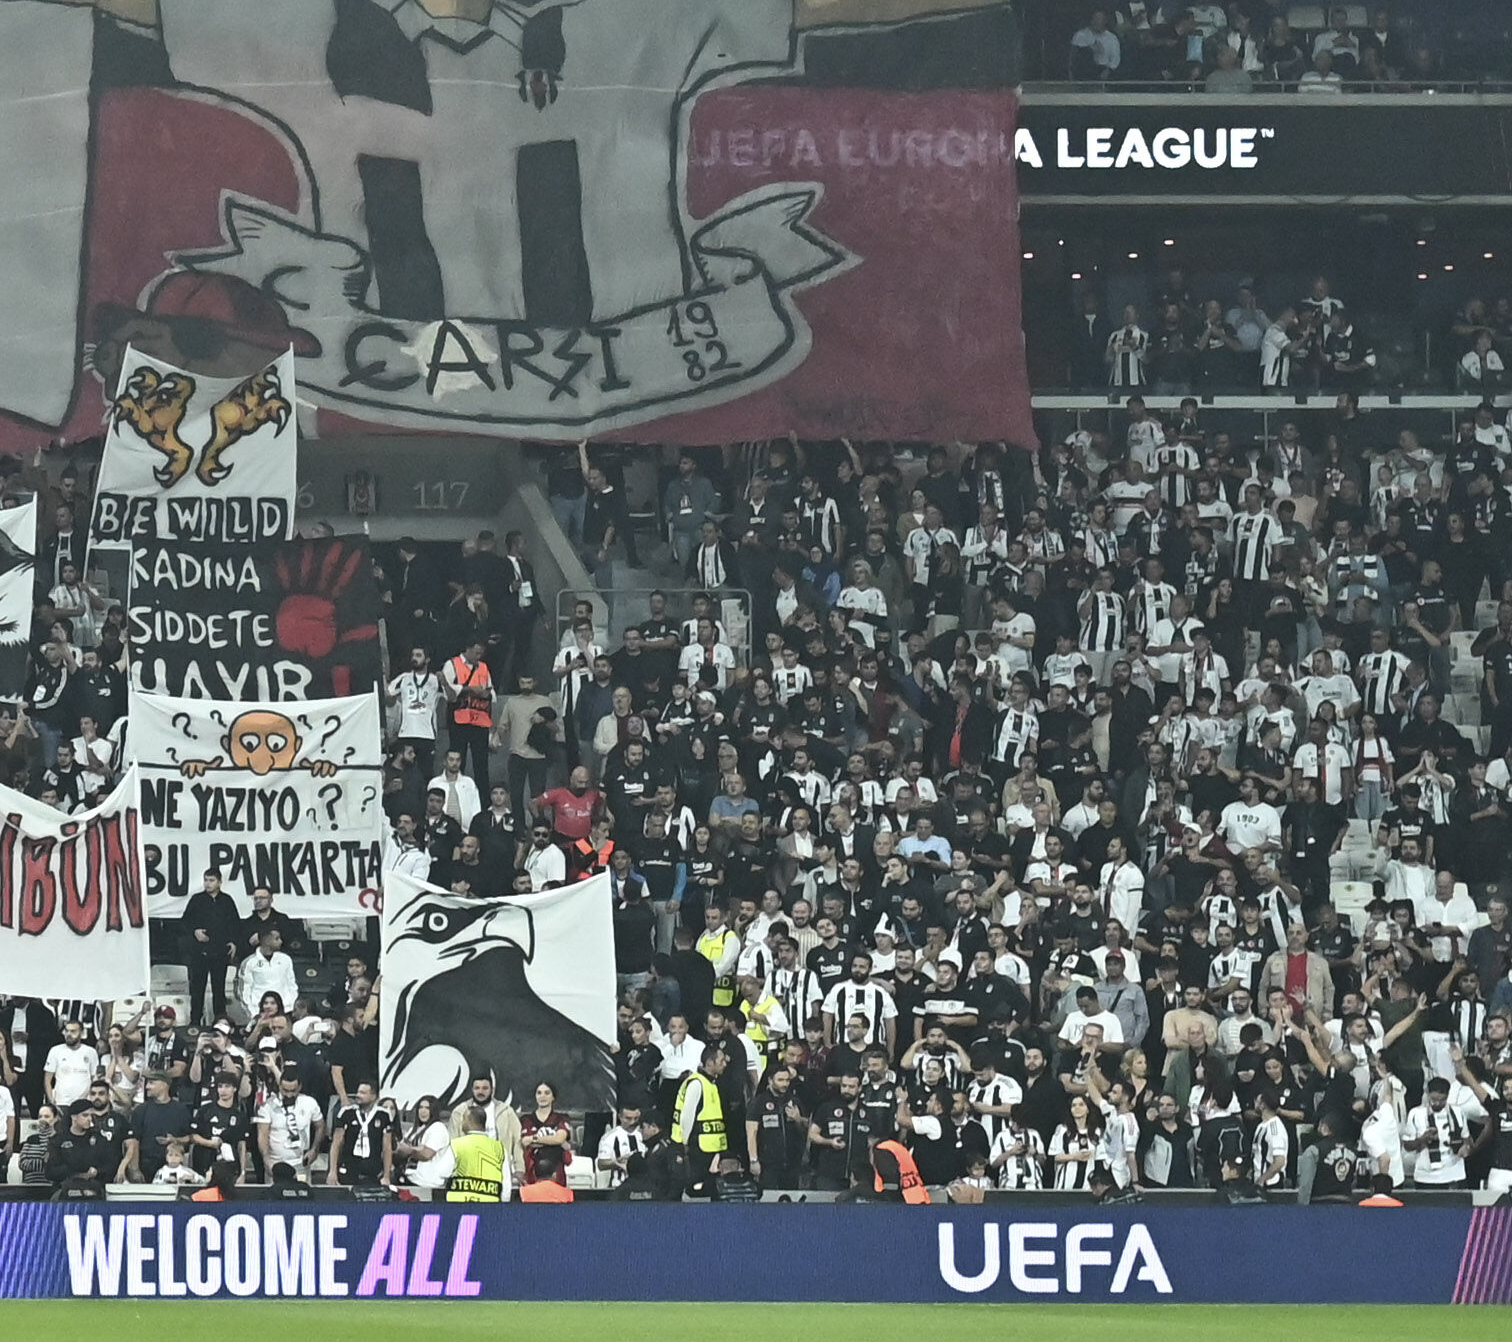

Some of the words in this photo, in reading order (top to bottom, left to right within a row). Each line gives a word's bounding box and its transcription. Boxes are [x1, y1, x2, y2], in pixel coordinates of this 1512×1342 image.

[96, 497, 155, 541] BE
[172, 497, 289, 543] WILD
[131, 547, 262, 593] KADINA
[130, 602, 273, 657] ŞİDDETE
[143, 778, 183, 829] NE
[189, 784, 300, 833] YAZIYO
[144, 842, 190, 897] BU
[210, 839, 382, 897] PANKARTTA
[64, 1214, 347, 1297] WELCOME
[356, 1214, 483, 1297] ALL
[938, 1222, 1174, 1293] UEFA
